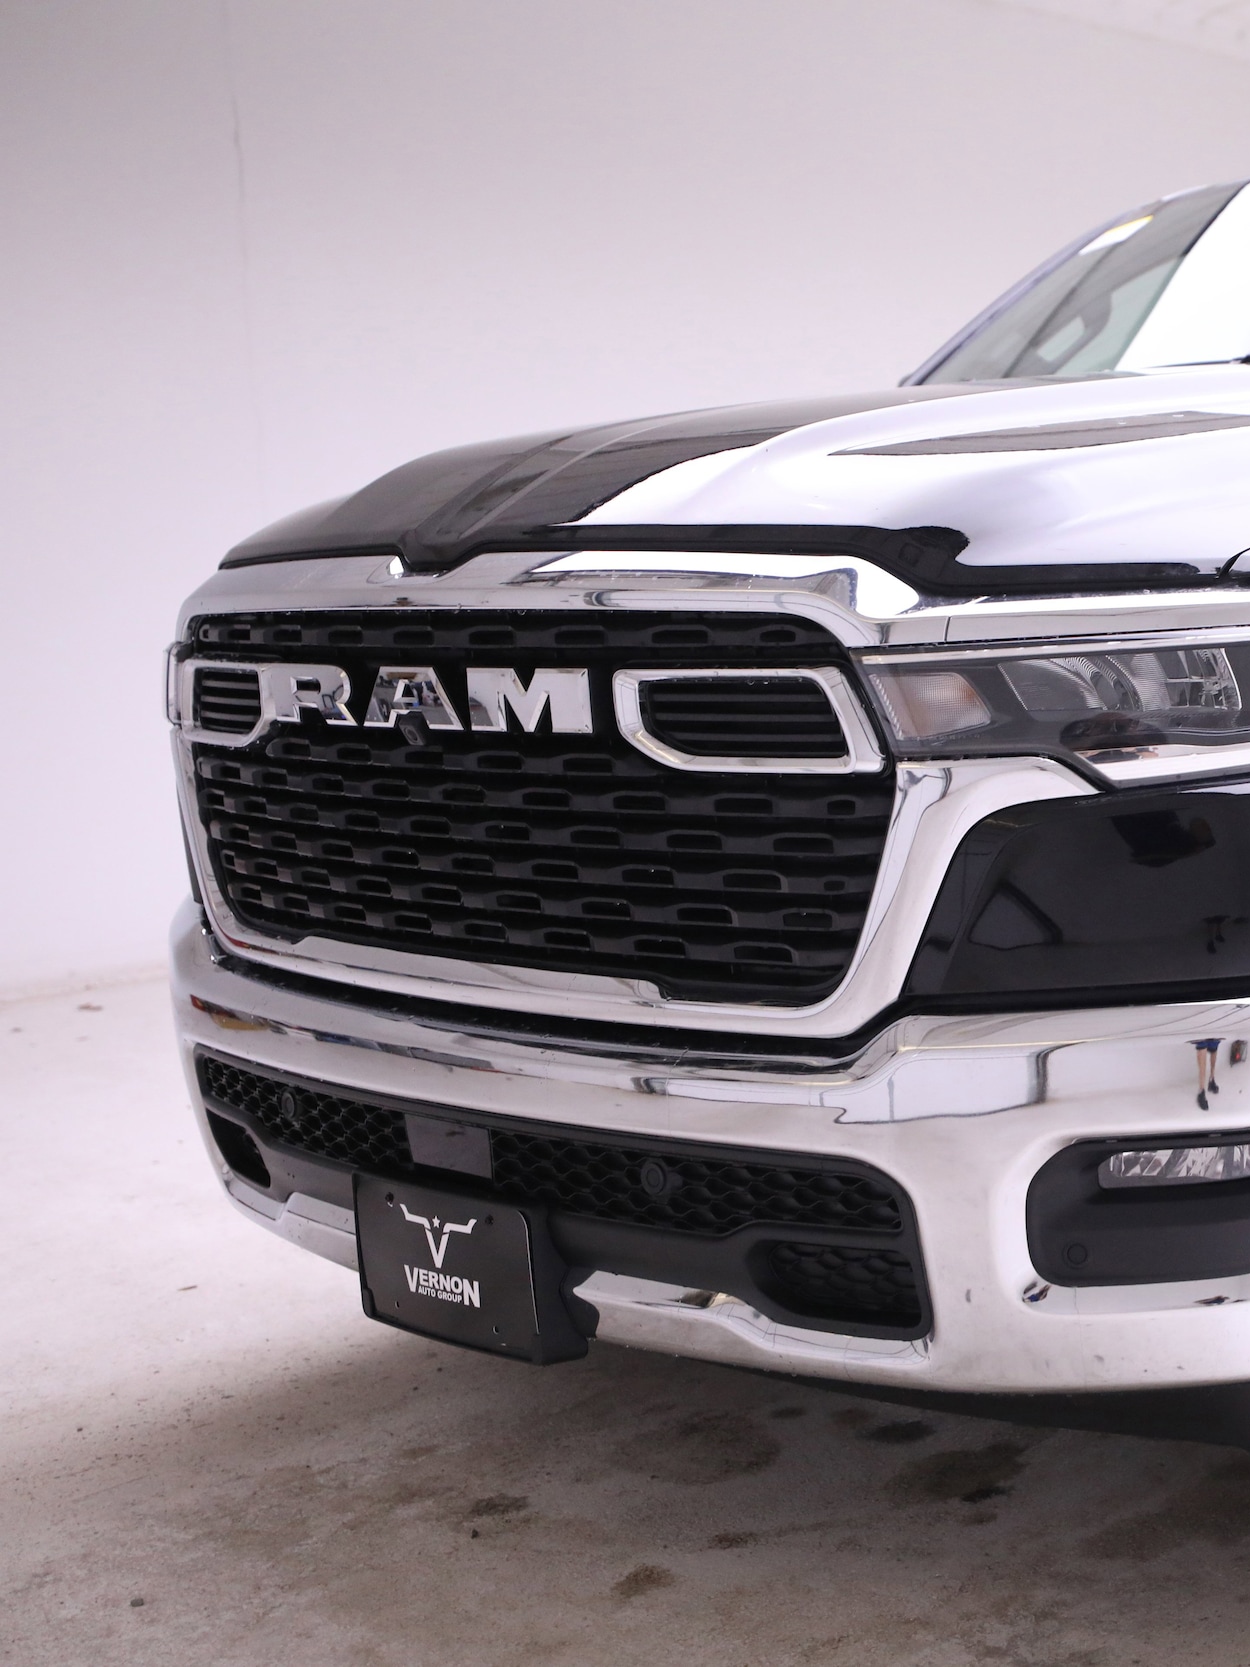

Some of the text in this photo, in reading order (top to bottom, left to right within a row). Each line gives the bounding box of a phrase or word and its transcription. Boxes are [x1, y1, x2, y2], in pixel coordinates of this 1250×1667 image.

[266, 666, 594, 734] RAM
[404, 1264, 481, 1308] VERNON
[418, 1285, 463, 1304] AUTO GROUP
